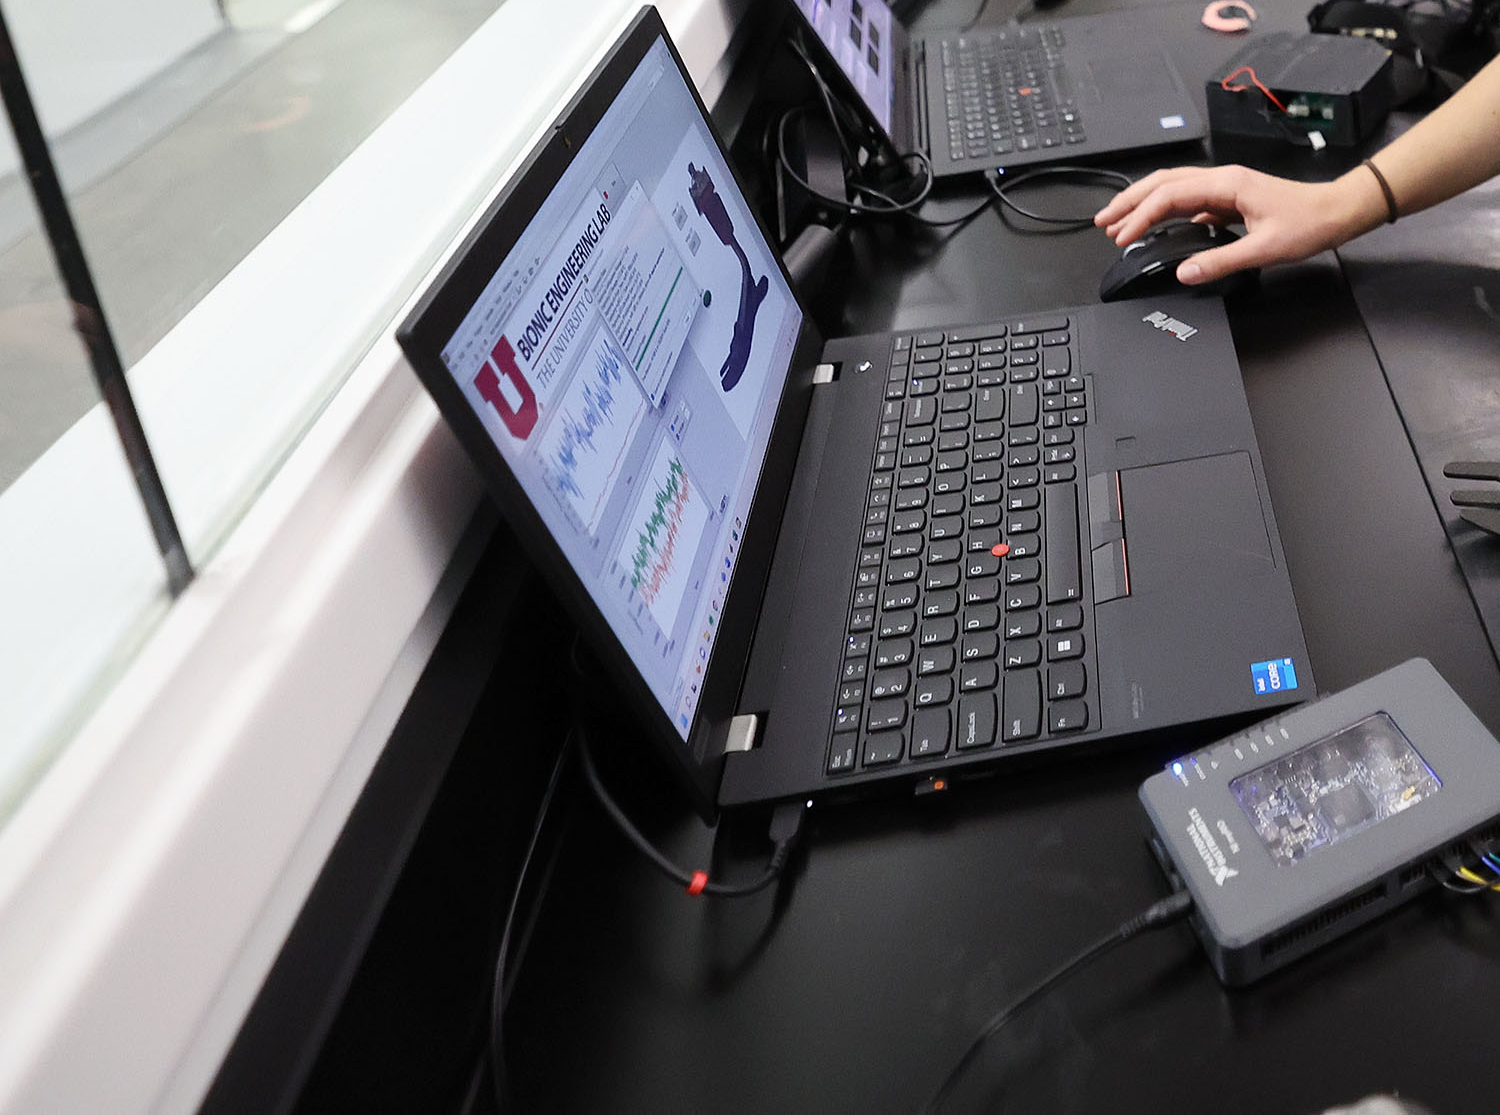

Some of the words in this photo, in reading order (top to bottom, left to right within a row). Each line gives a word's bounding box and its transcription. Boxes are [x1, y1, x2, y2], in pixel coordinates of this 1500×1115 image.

[516, 301, 553, 361] BIONIC
[545, 225, 599, 311] ENGINEERING
[592, 203, 611, 235] LAB
[536, 358, 555, 389] THE
[549, 296, 588, 366] UNIVERSITY
[473, 334, 539, 441] U
[1012, 499, 1022, 508] M
[1010, 598, 1022, 607] C
[927, 605, 939, 614] R
[1010, 626, 1021, 635] X
[966, 648, 978, 657] S
[1009, 656, 1021, 665] Z
[922, 661, 934, 672] W
[920, 693, 932, 702] Q
[1188, 807, 1227, 868] INSTRUMENTS
[1187, 823, 1215, 871] NATIONAL
